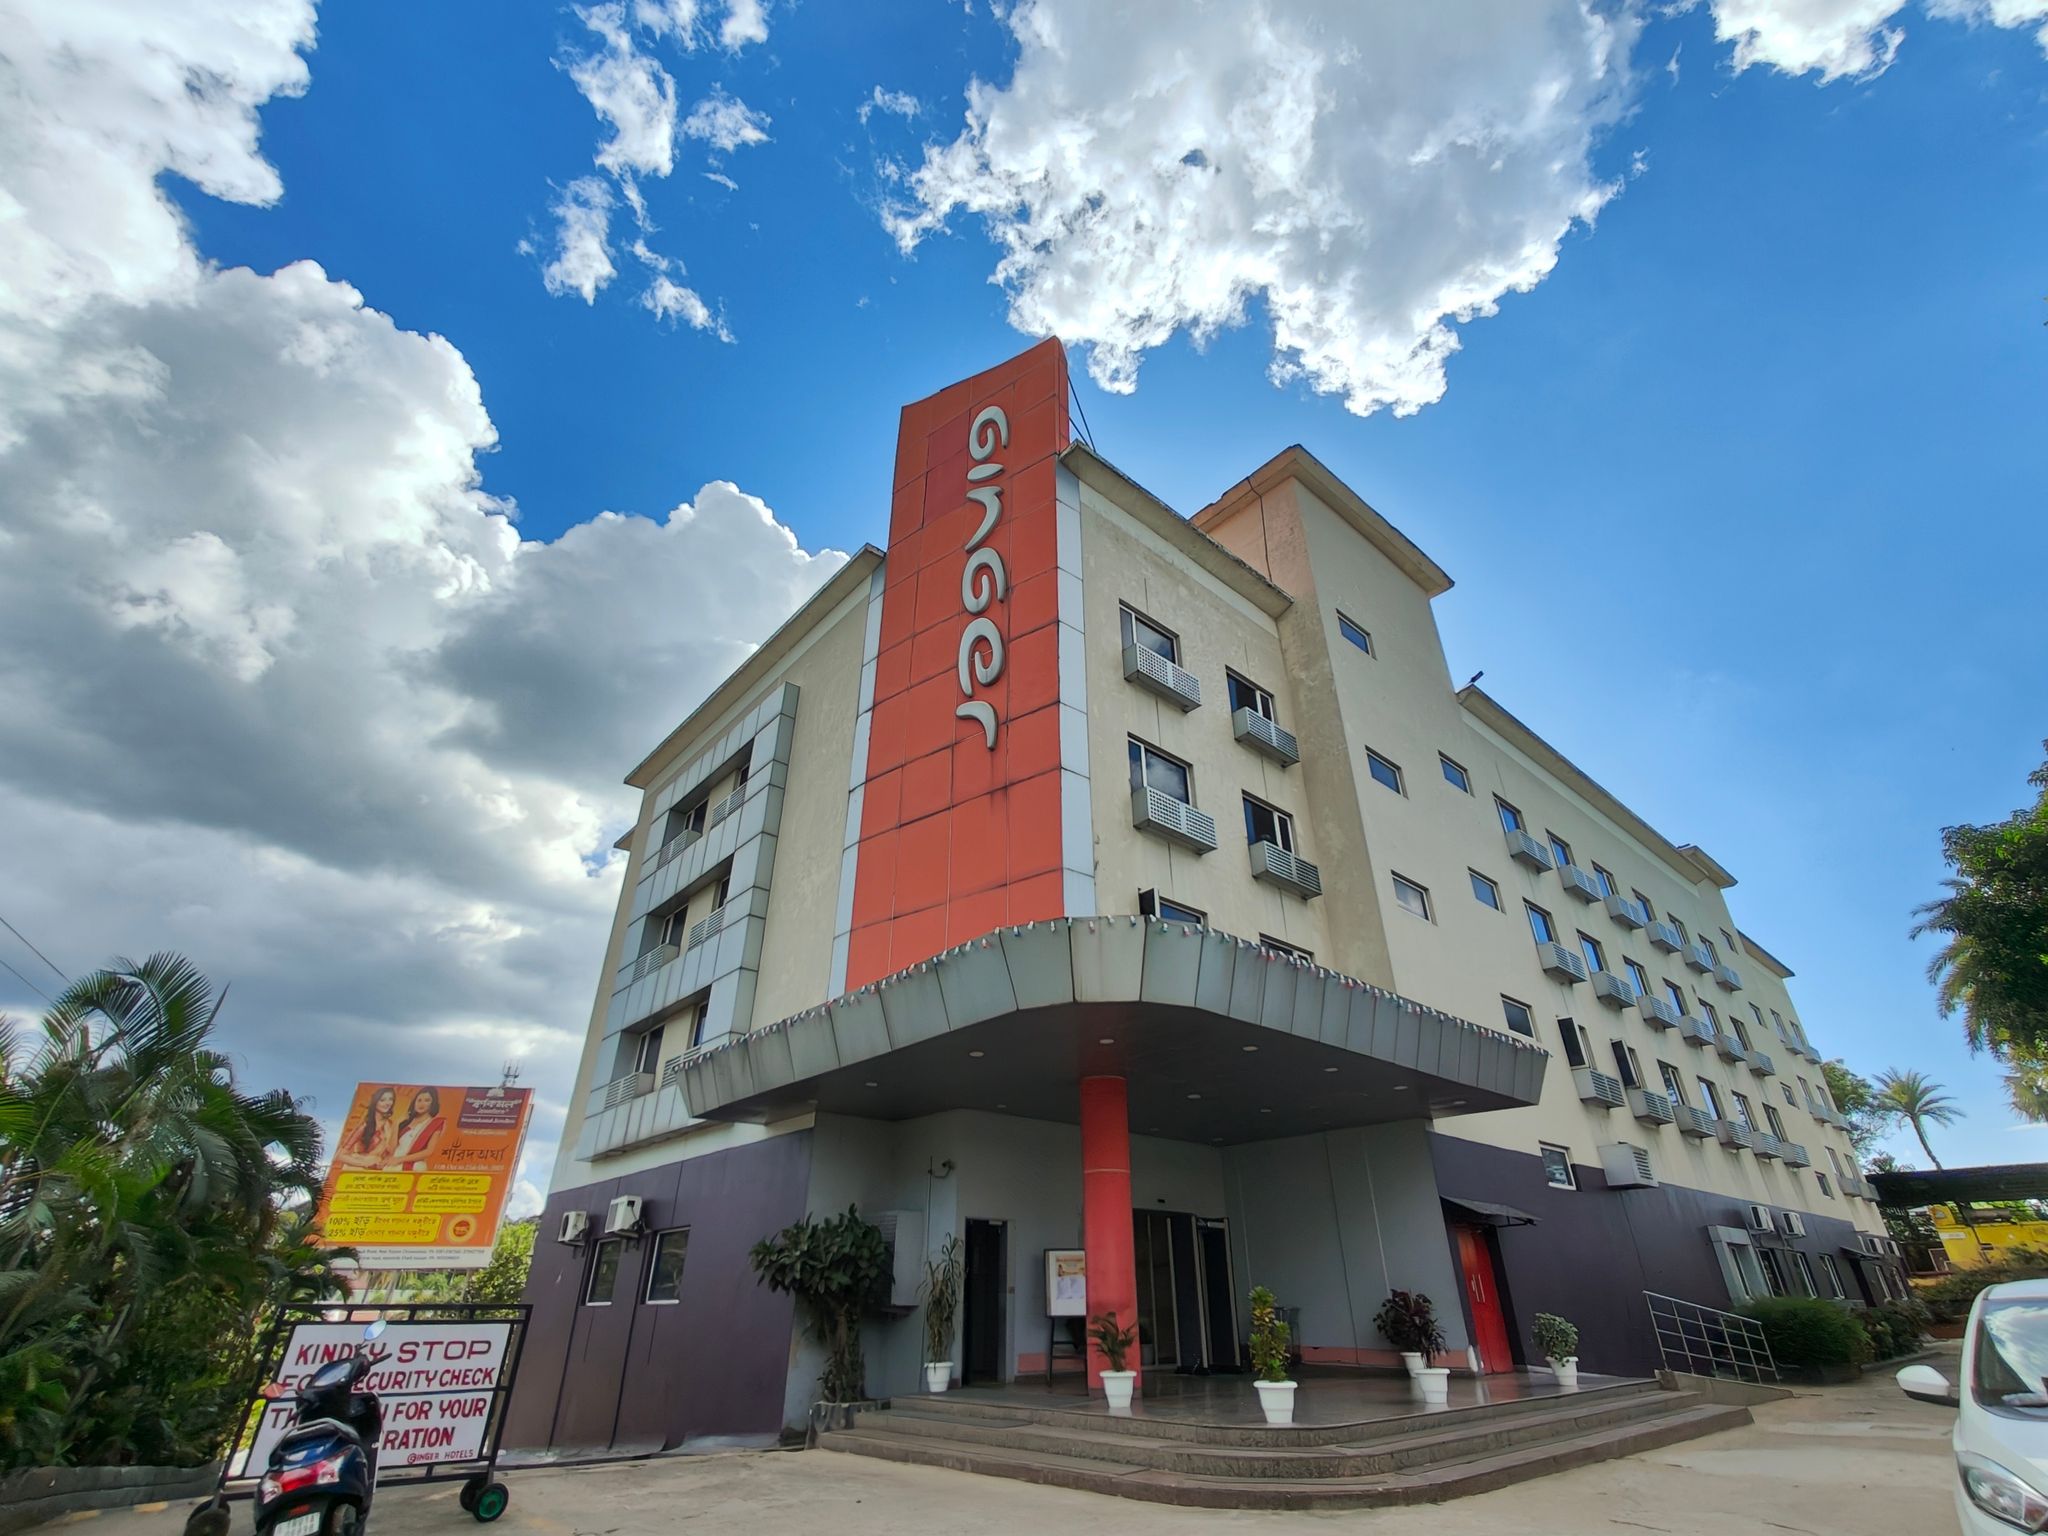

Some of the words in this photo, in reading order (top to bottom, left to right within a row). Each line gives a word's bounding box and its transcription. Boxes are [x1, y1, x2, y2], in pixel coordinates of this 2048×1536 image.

[328, 1229, 346, 1237] 25%
[295, 1342, 387, 1366] KINDY
[397, 1340, 492, 1363] STOP
[351, 1370, 438, 1392] ECURITY
[439, 1367, 496, 1388] CHECK
[392, 1400, 433, 1422] FOR
[439, 1398, 487, 1419] YOUR
[444, 1449, 474, 1460] HOTELS
